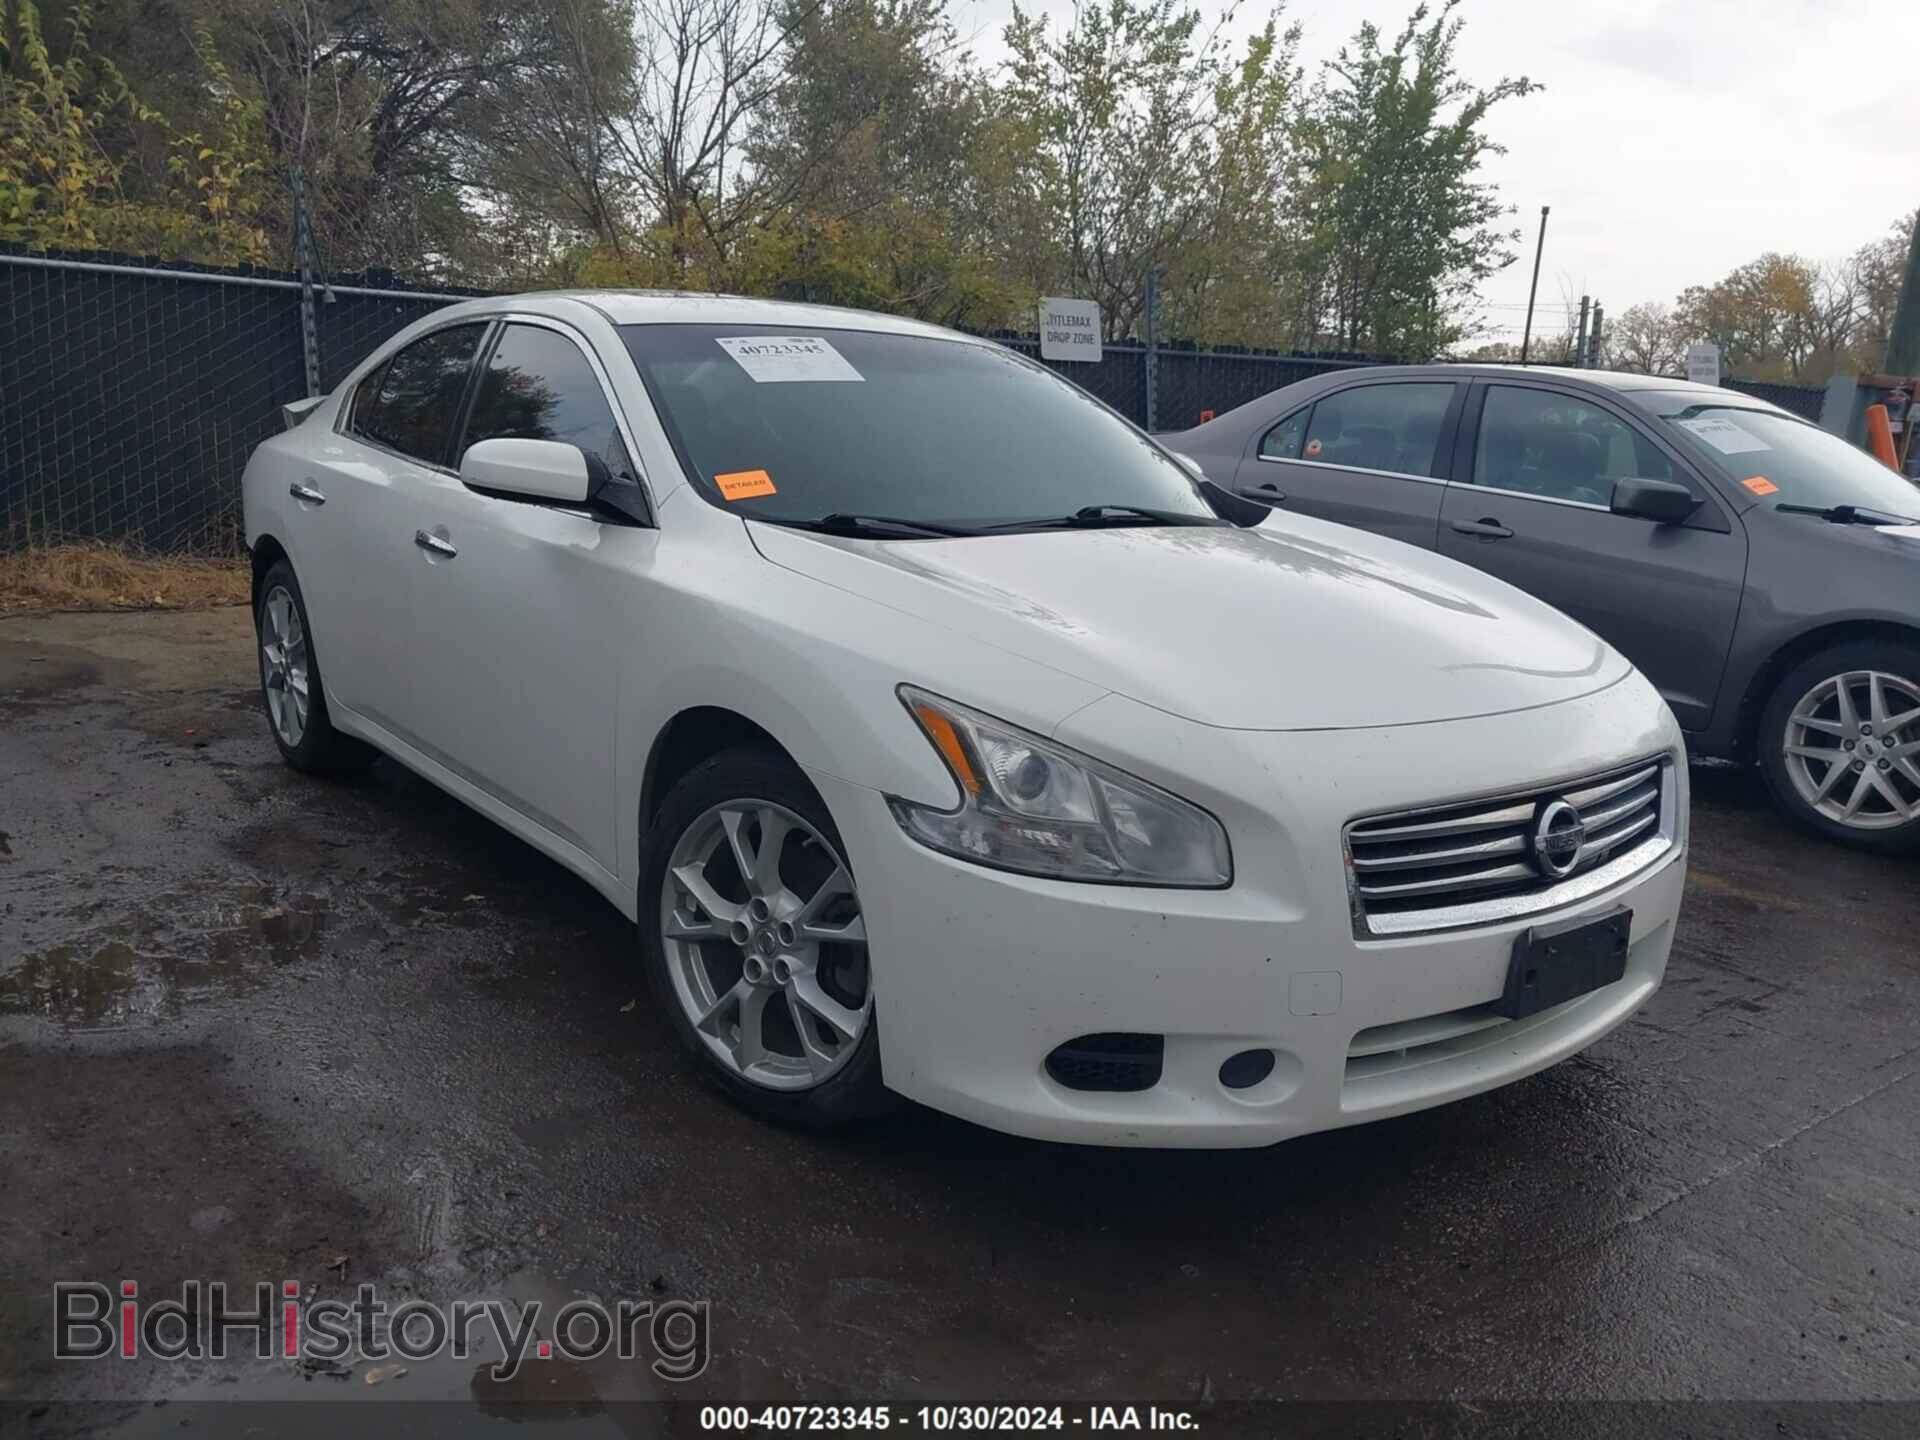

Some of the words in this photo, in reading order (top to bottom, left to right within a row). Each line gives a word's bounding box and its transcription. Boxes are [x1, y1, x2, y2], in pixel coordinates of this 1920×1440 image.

[1047, 331, 1070, 343] DROP
[1073, 333, 1096, 344] ZONE
[738, 344, 825, 354] 40723345
